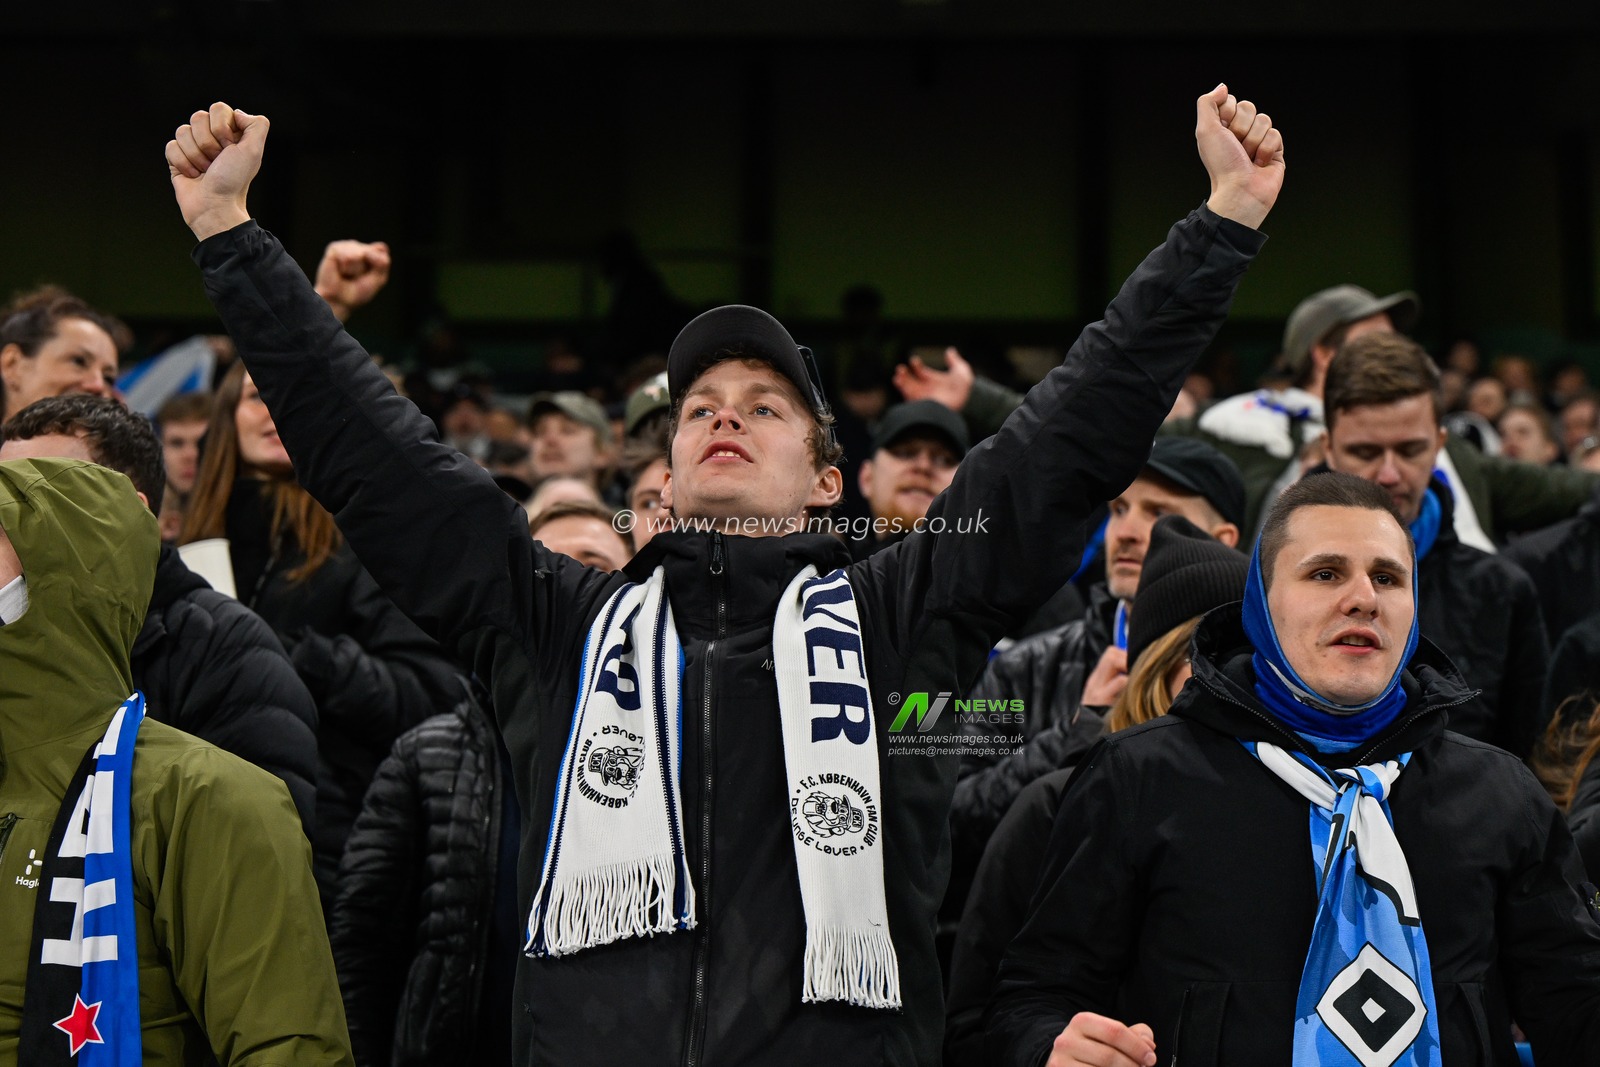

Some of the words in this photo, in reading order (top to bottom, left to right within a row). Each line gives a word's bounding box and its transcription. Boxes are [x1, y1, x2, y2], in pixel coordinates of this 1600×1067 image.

[578, 738, 593, 763] CLUB
[578, 779, 628, 808] KØBENHAVN
[799, 776, 819, 789] F.C.
[818, 773, 872, 804] KØBENHAVN
[866, 804, 878, 823] FAN
[863, 823, 878, 846] CLUB
[815, 841, 857, 856] LØVER
